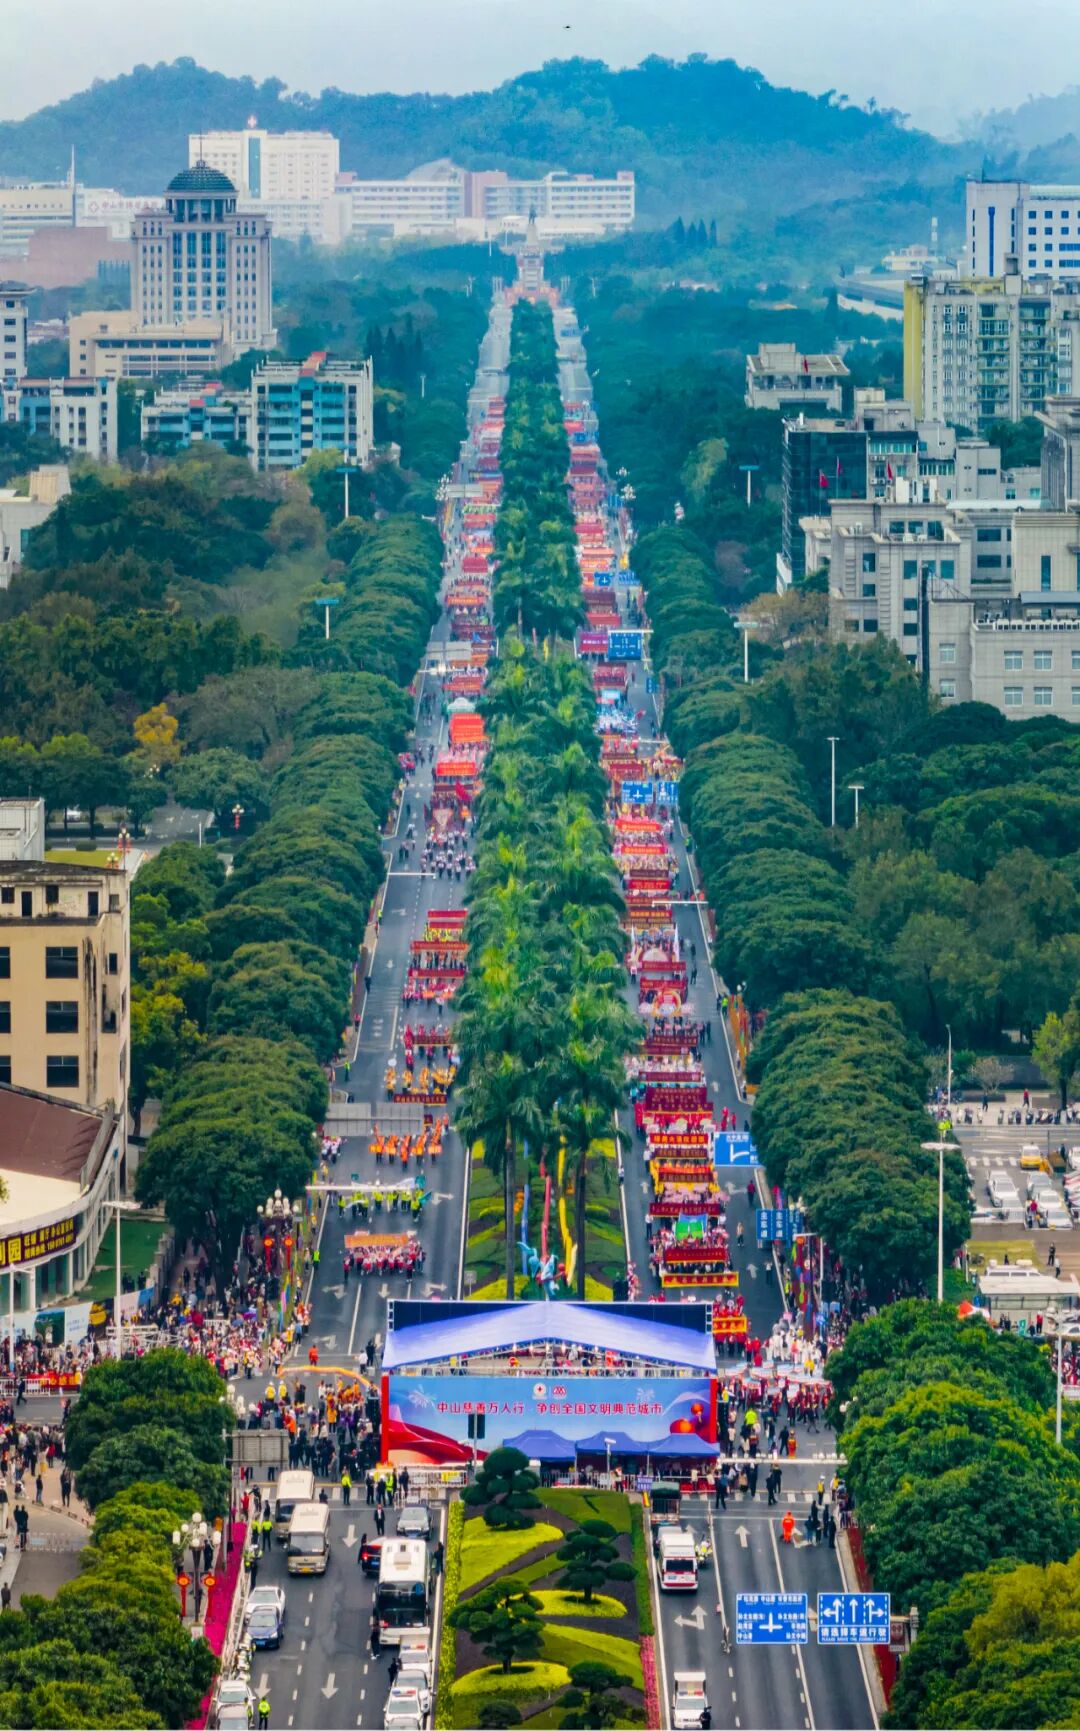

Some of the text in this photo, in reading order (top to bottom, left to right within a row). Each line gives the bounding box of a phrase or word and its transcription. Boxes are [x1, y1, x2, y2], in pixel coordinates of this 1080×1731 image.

[437, 1402, 663, 1414] 中山慈善万人行 争创全国文明典范城市
